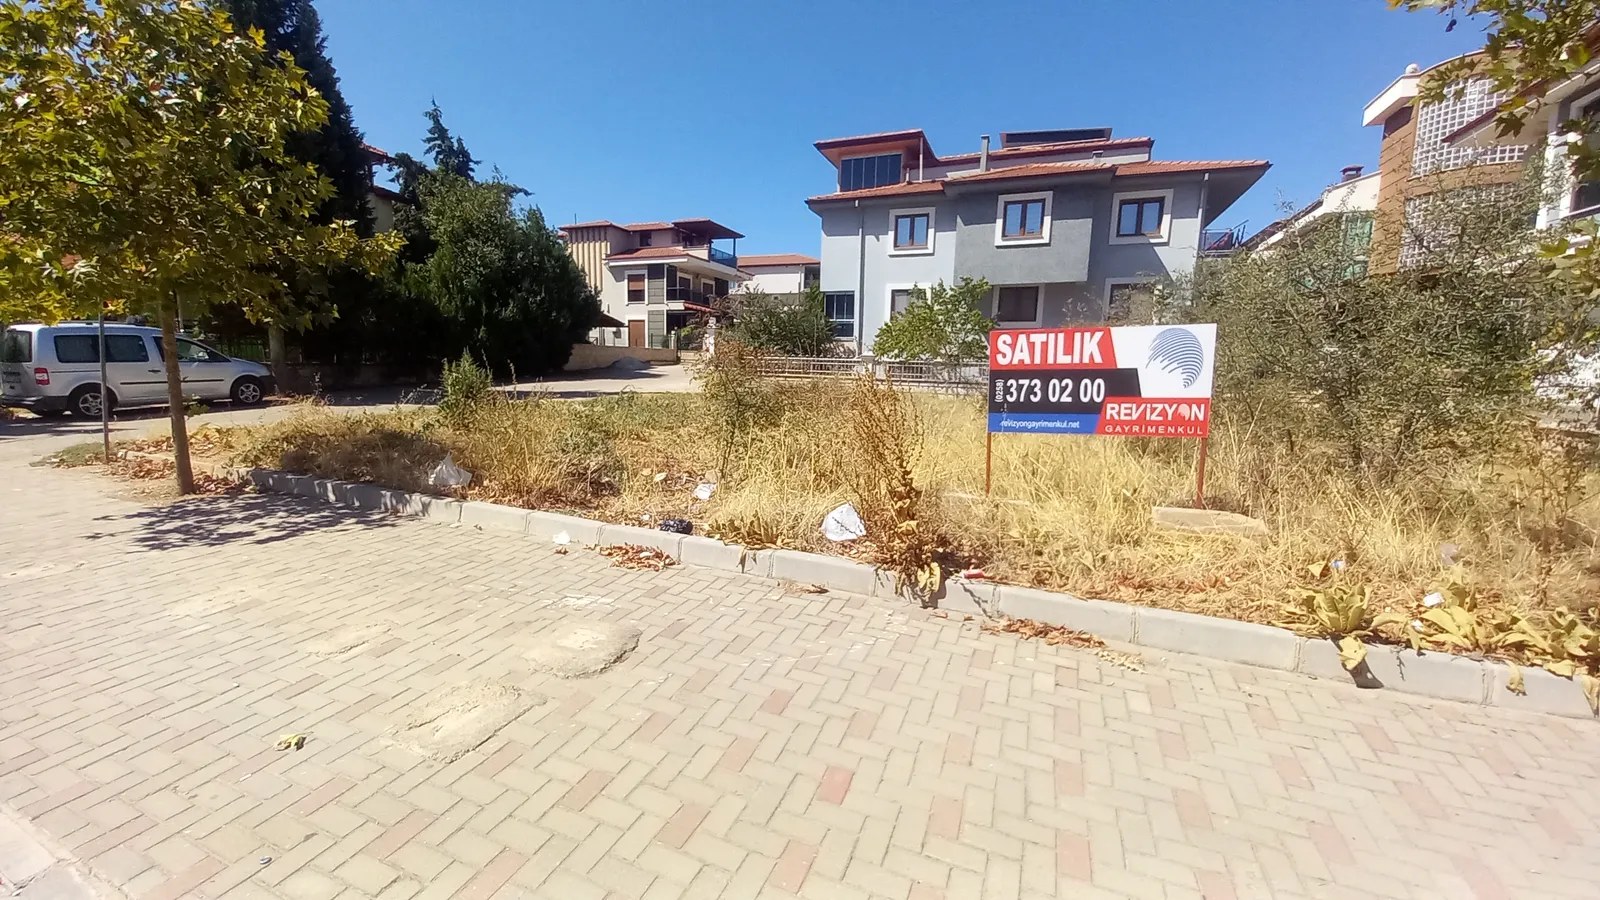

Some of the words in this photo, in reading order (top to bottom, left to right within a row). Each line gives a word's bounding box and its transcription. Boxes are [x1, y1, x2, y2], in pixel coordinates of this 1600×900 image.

[995, 330, 1104, 366] SATILIK
[995, 379, 1004, 402] (0258)
[1006, 378, 1041, 402] 373
[1048, 378, 1073, 402] 02
[1079, 378, 1105, 402] 00
[1001, 419, 1080, 429] revizyongayrimenkul.net
[1105, 424, 1203, 434] GAYRİMENKUL
